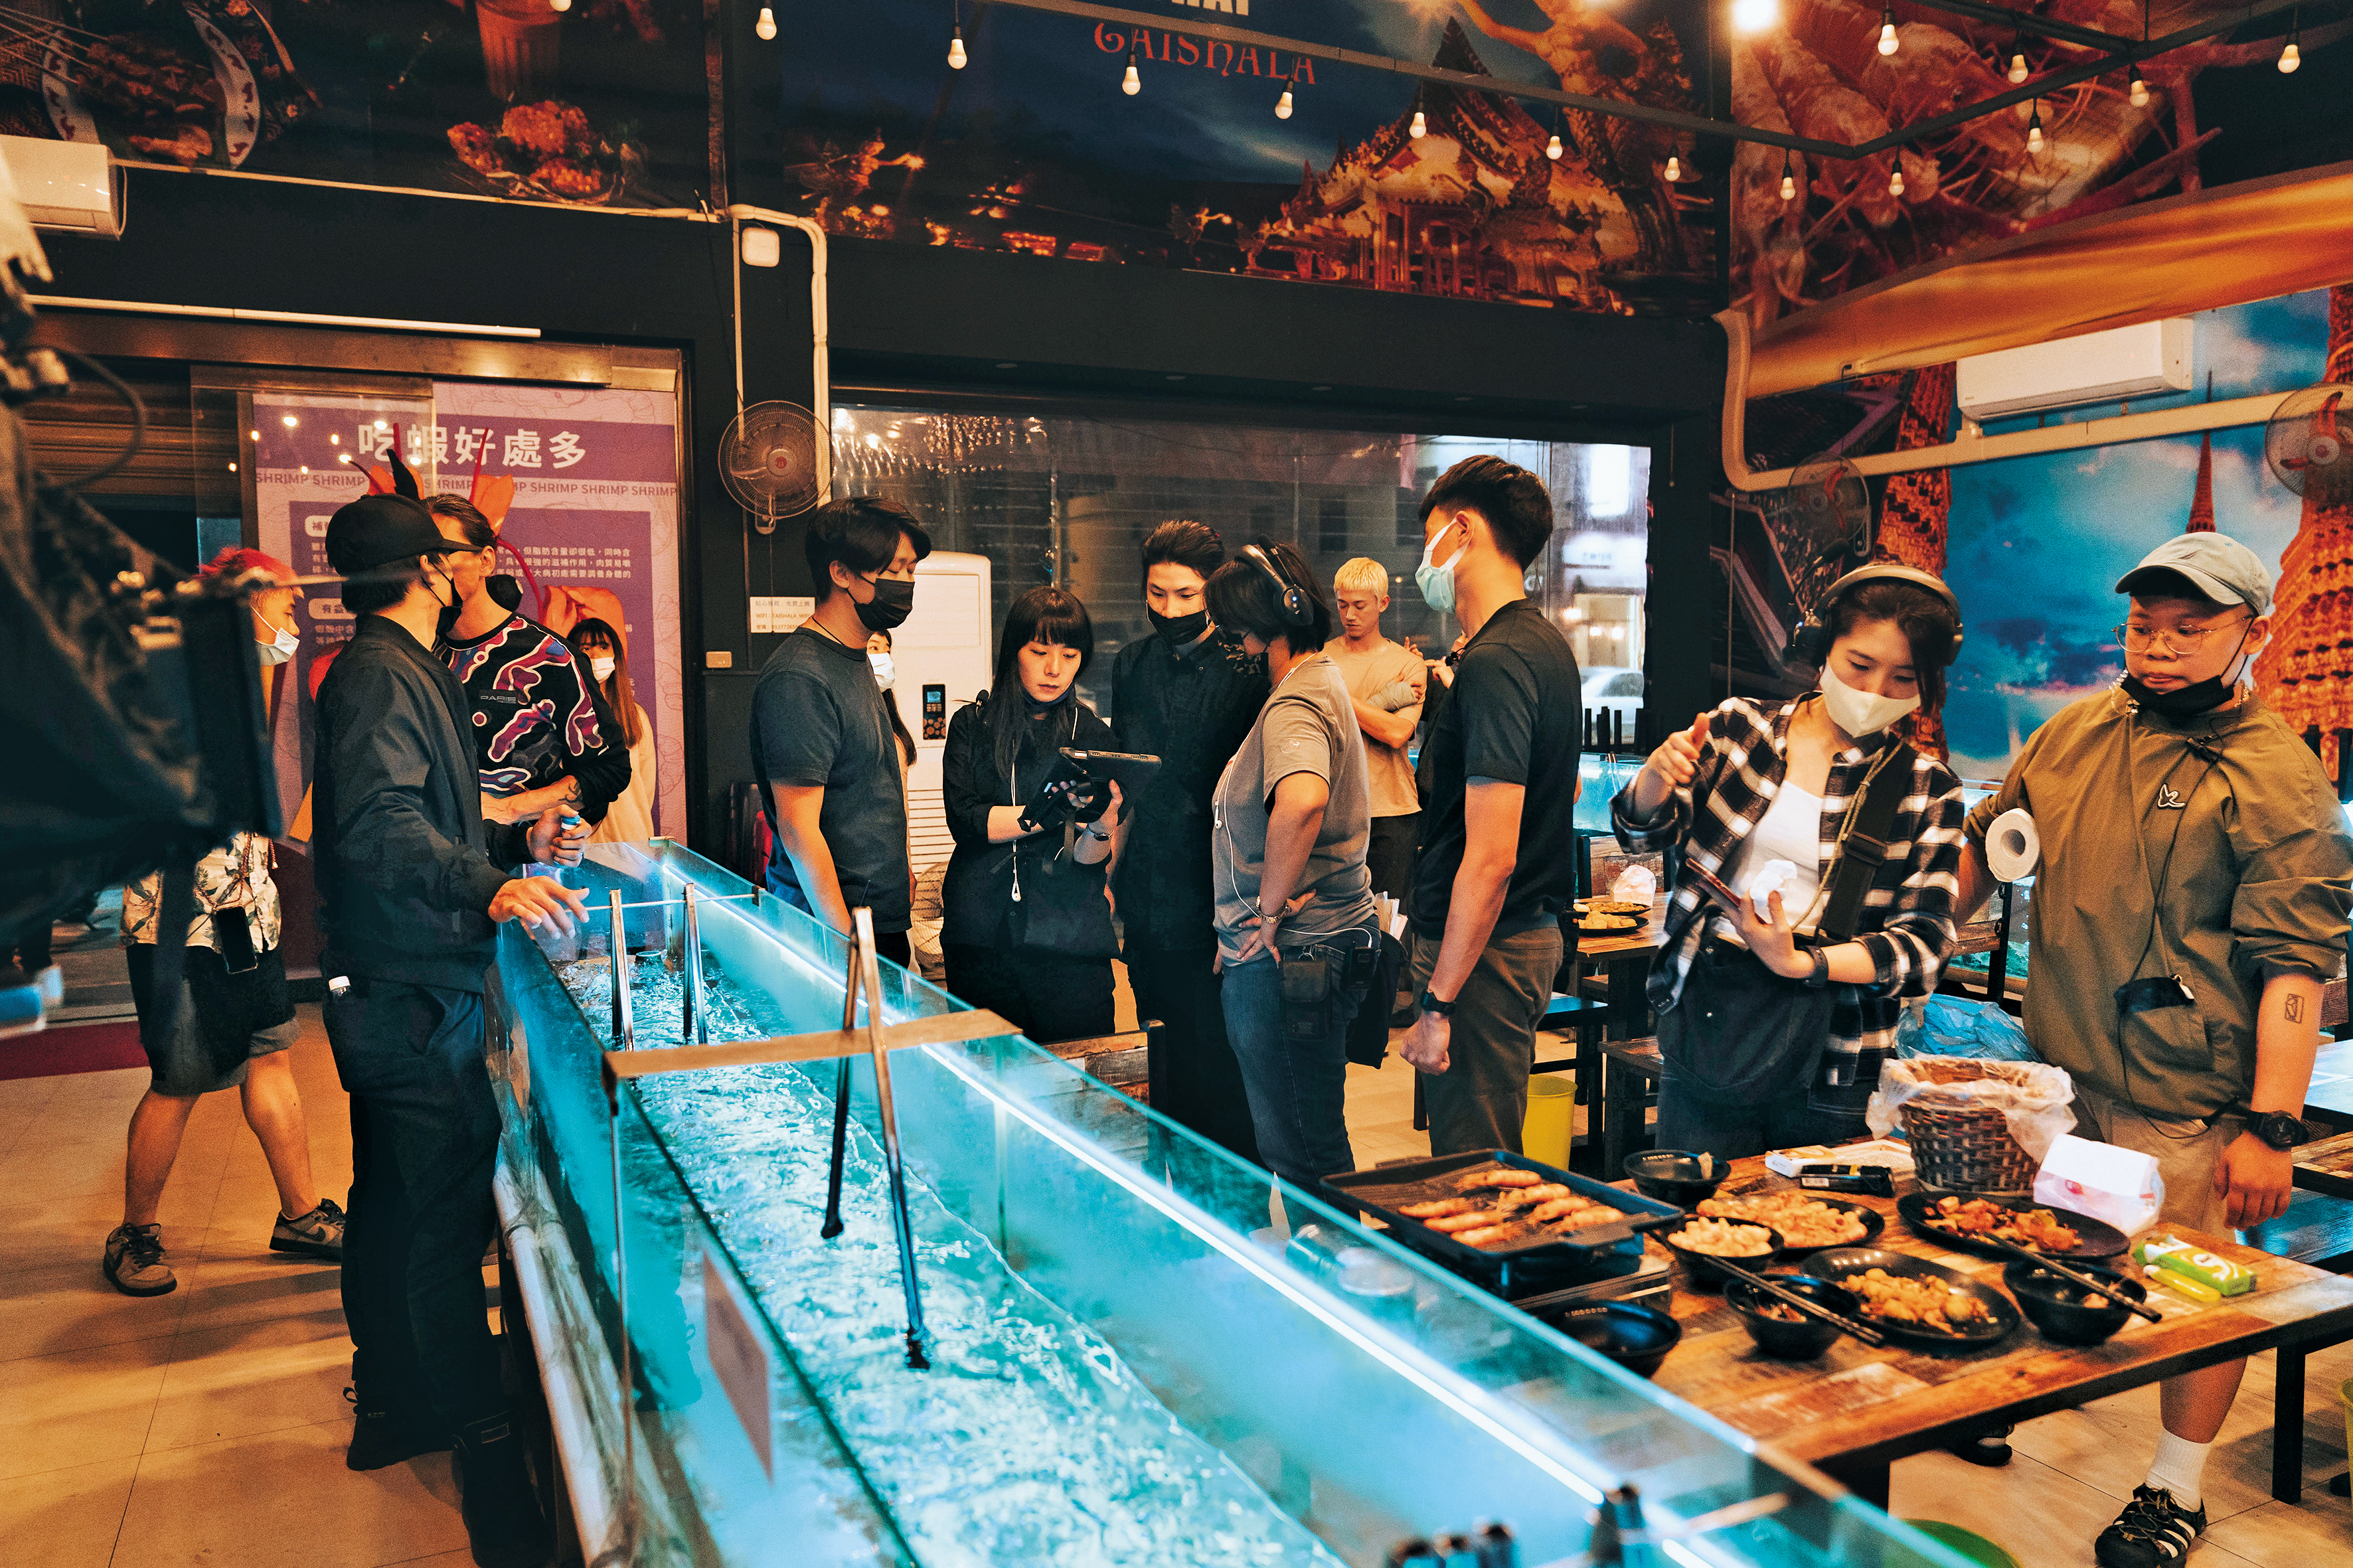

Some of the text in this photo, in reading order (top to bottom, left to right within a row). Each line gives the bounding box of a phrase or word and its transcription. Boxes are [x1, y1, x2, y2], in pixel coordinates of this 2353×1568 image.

[358, 424, 586, 469] 吃蝦好處多
[256, 473, 309, 484] SHRIMP
[313, 475, 365, 486] SHRIMP
[530, 482, 578, 493] SHRIMP
[582, 484, 628, 495] SHRIMP
[631, 486, 676, 497] SHRIMP
